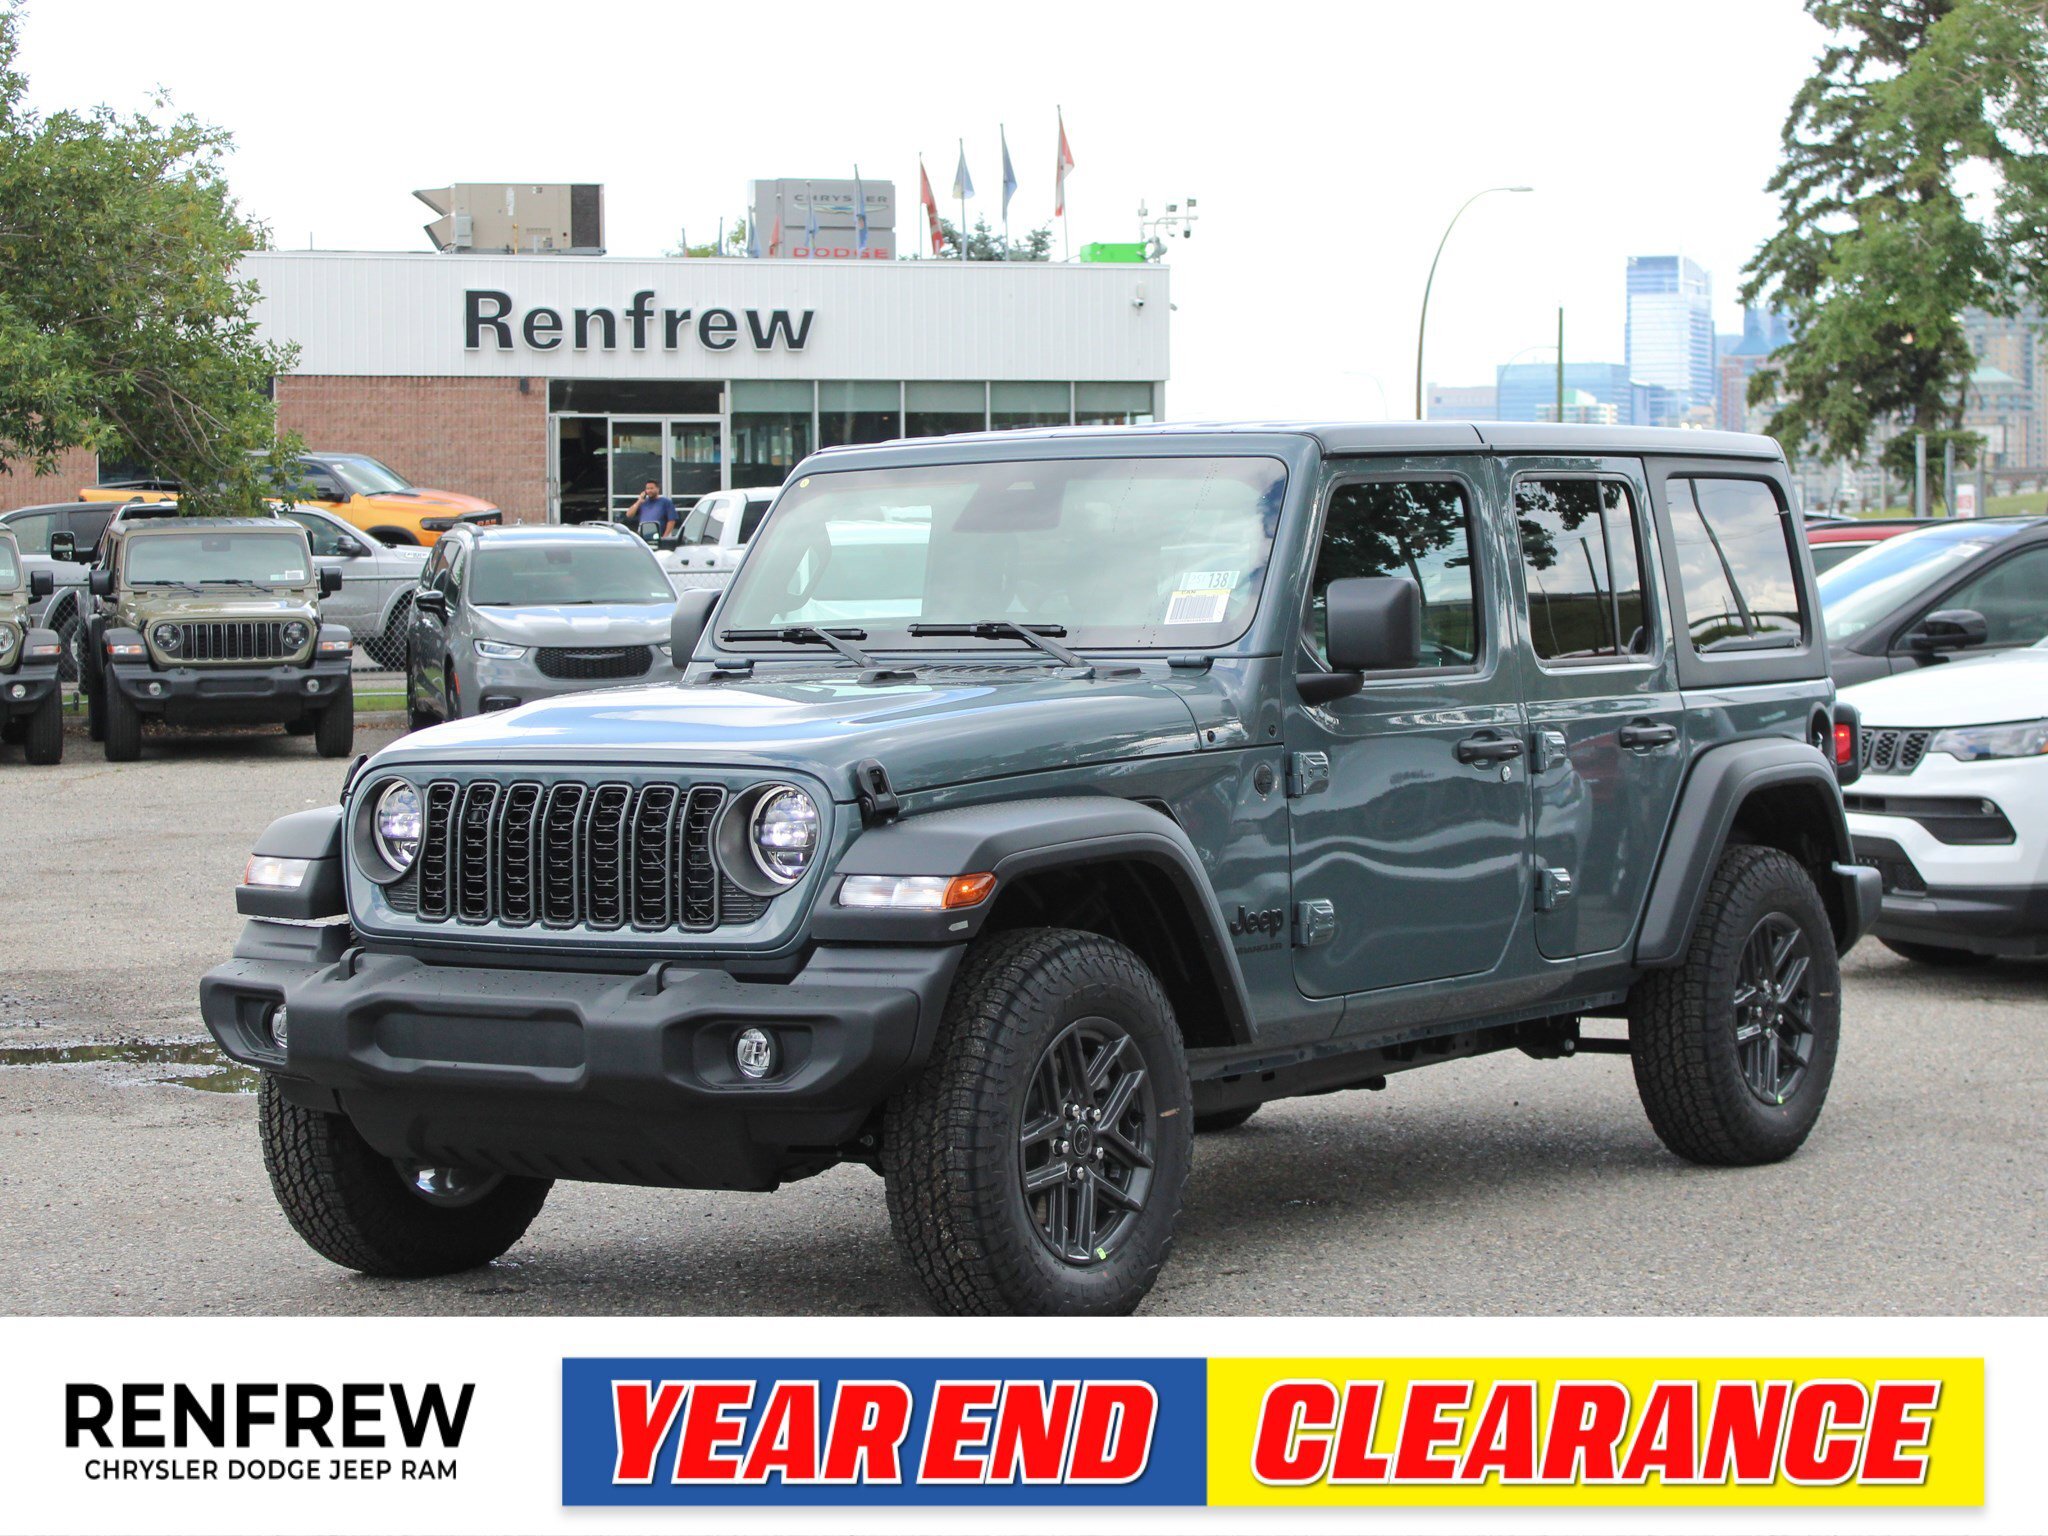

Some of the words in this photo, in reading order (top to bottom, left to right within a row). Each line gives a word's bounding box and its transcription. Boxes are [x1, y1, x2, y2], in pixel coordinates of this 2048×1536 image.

[794, 194, 888, 202] CRYSER
[464, 290, 815, 350] Renfrew
[1229, 905, 1284, 938] Jeep
